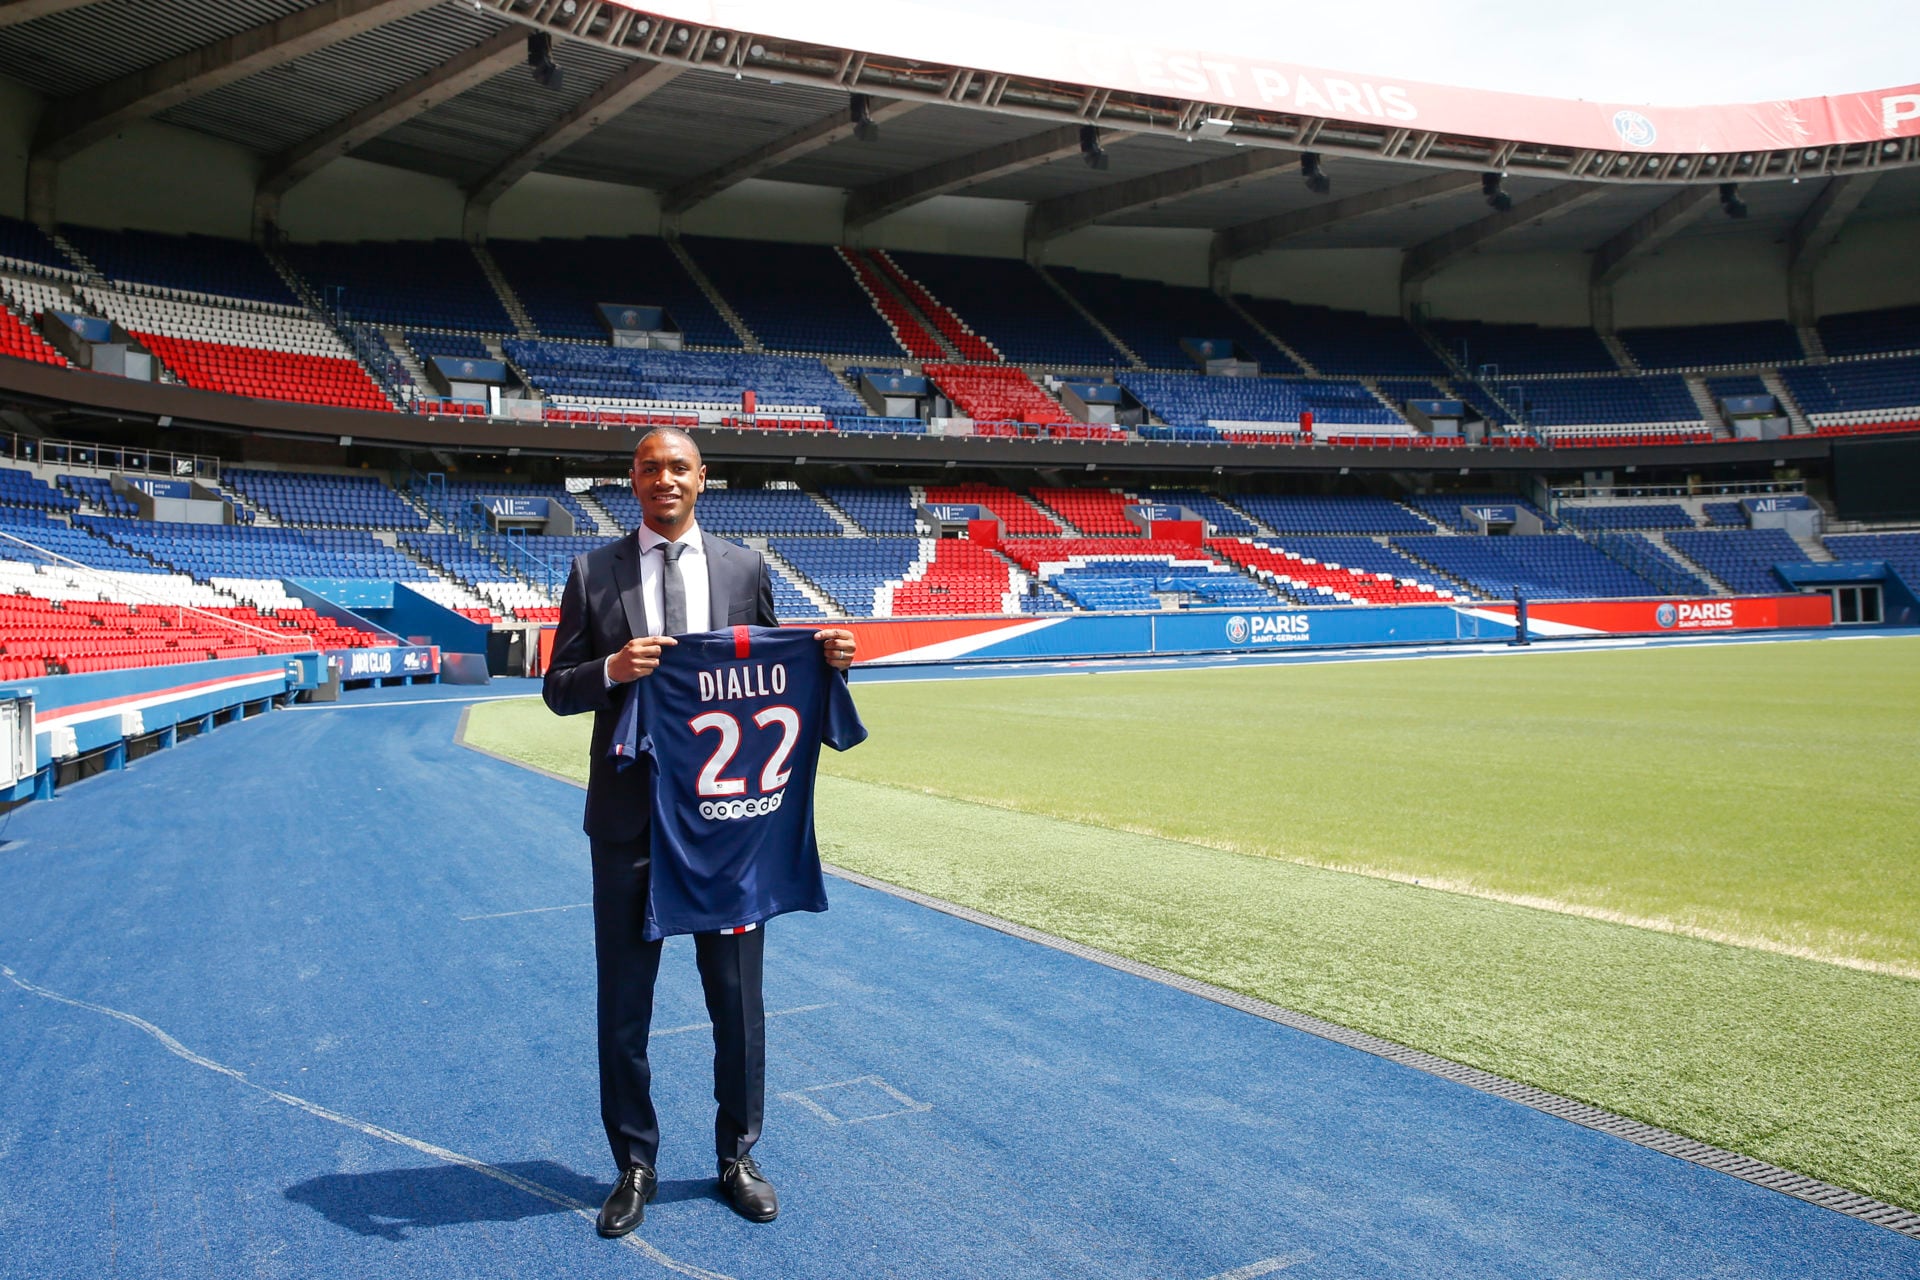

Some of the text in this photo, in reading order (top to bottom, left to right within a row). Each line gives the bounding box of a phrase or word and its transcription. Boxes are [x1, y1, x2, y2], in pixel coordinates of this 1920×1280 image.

[1249, 65, 1418, 121] PARIS
[1678, 602, 1733, 620] PARIS
[1251, 614, 1310, 634] PARIS
[1678, 619, 1733, 628] SAINT-GERMAIN
[1251, 633, 1309, 643] SAINT-GERMAIN
[698, 663, 786, 702] DIALLO
[688, 704, 802, 797] 22
